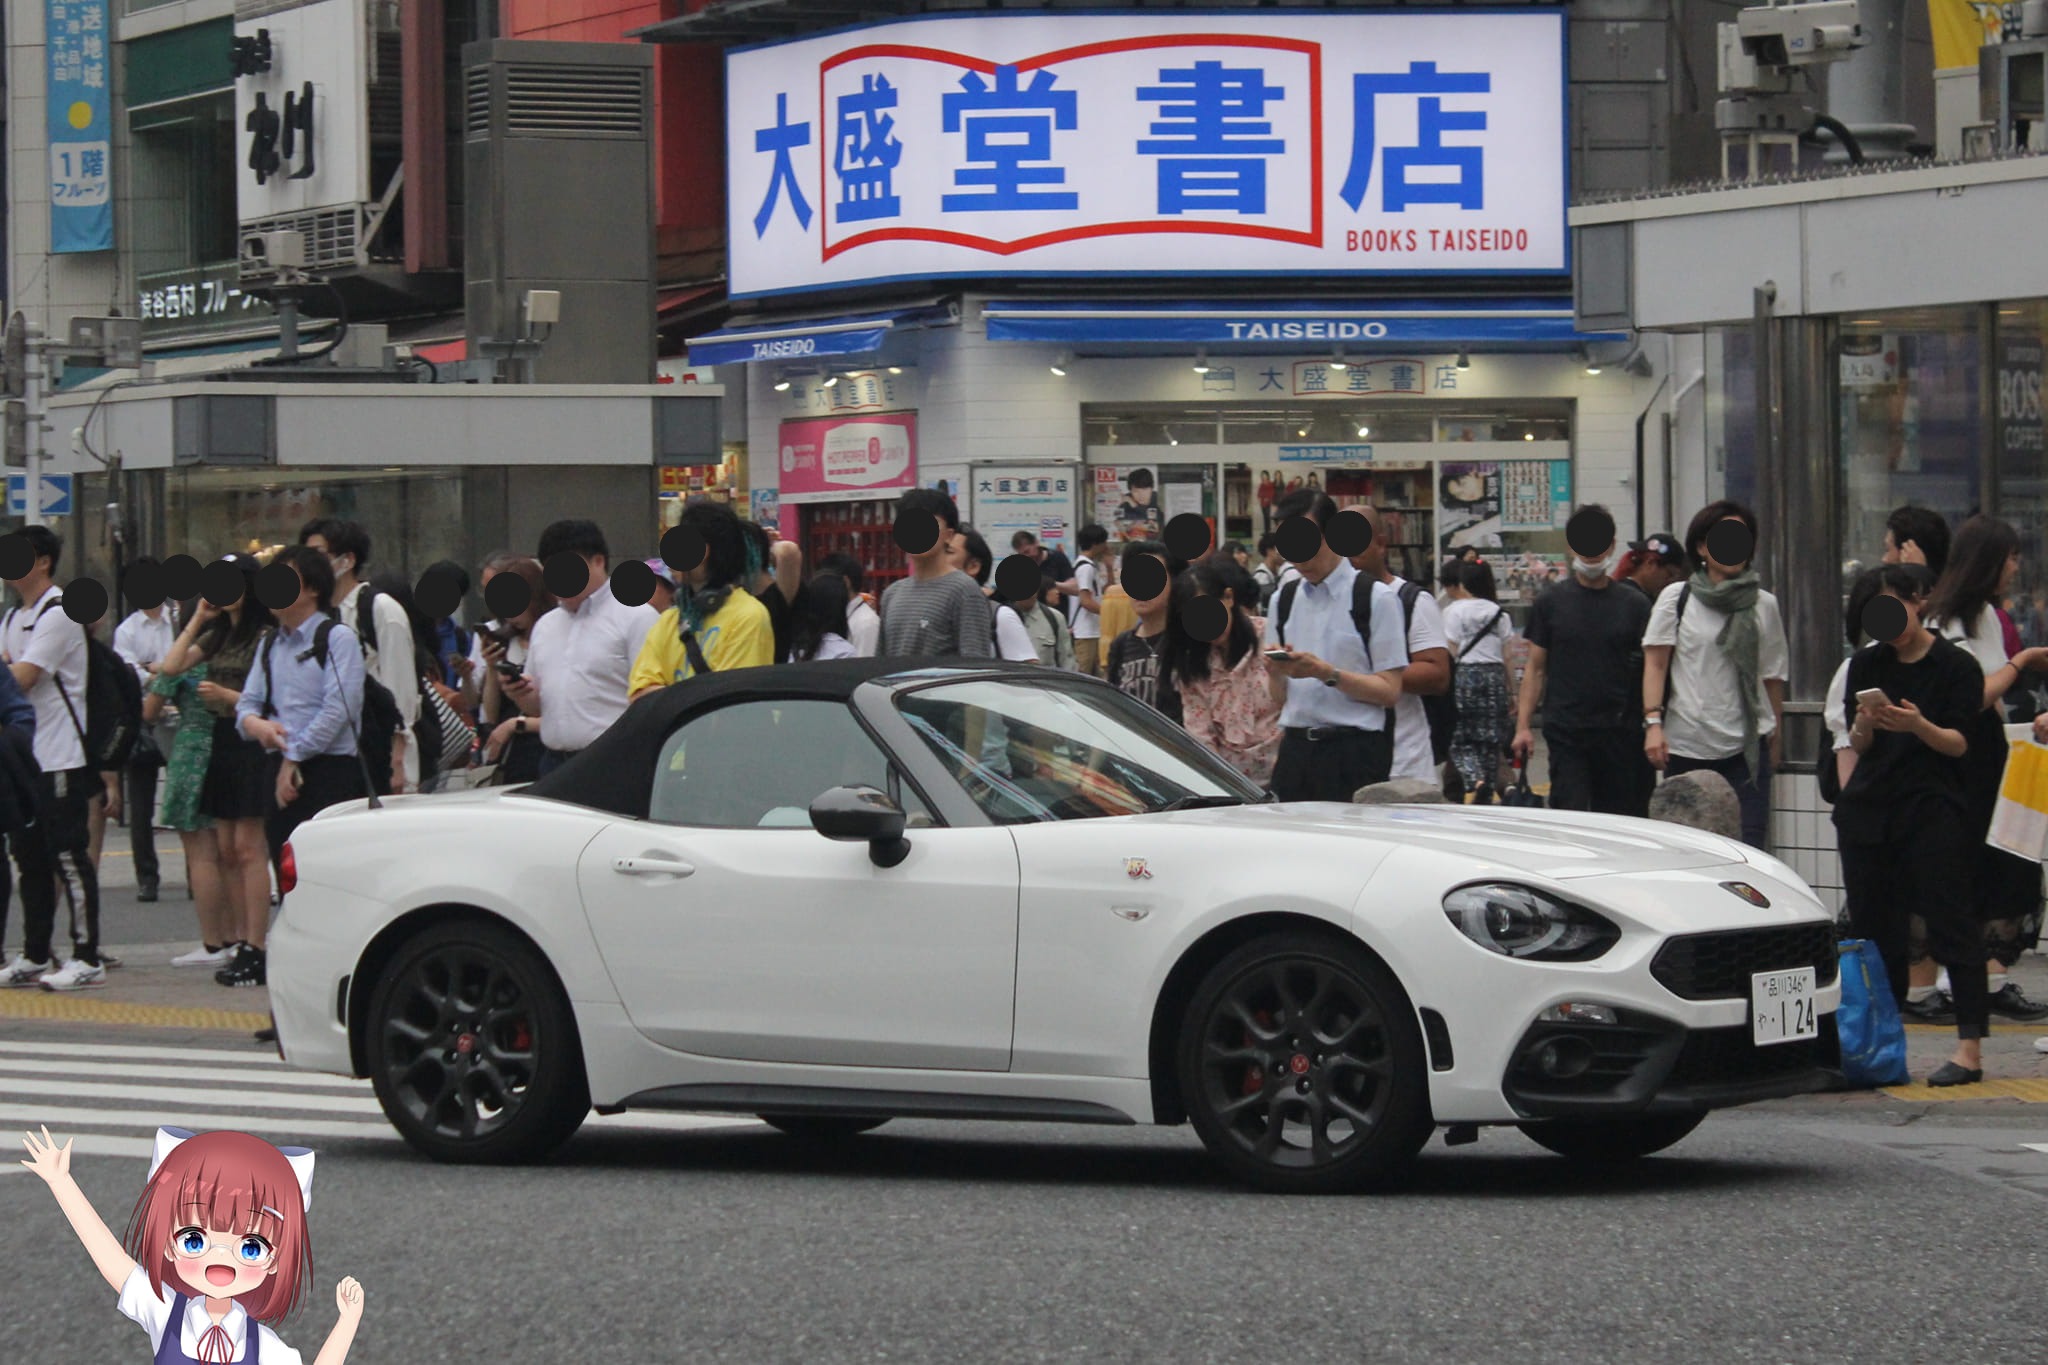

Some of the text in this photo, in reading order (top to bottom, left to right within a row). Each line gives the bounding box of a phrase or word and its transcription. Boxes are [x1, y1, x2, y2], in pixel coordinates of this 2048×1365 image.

[60, 149, 104, 177] 1階
[753, 60, 1492, 241] 大盛堂書店
[1346, 228, 1528, 252] BOOKS TAISEIDO
[1225, 321, 1388, 340] TAISEIDO
[751, 338, 816, 358] TAISEIDO
[1258, 364, 1458, 392] 大盛堂書店
[1999, 369, 2043, 420] BOS
[979, 479, 1068, 493] 大盛堂書店
